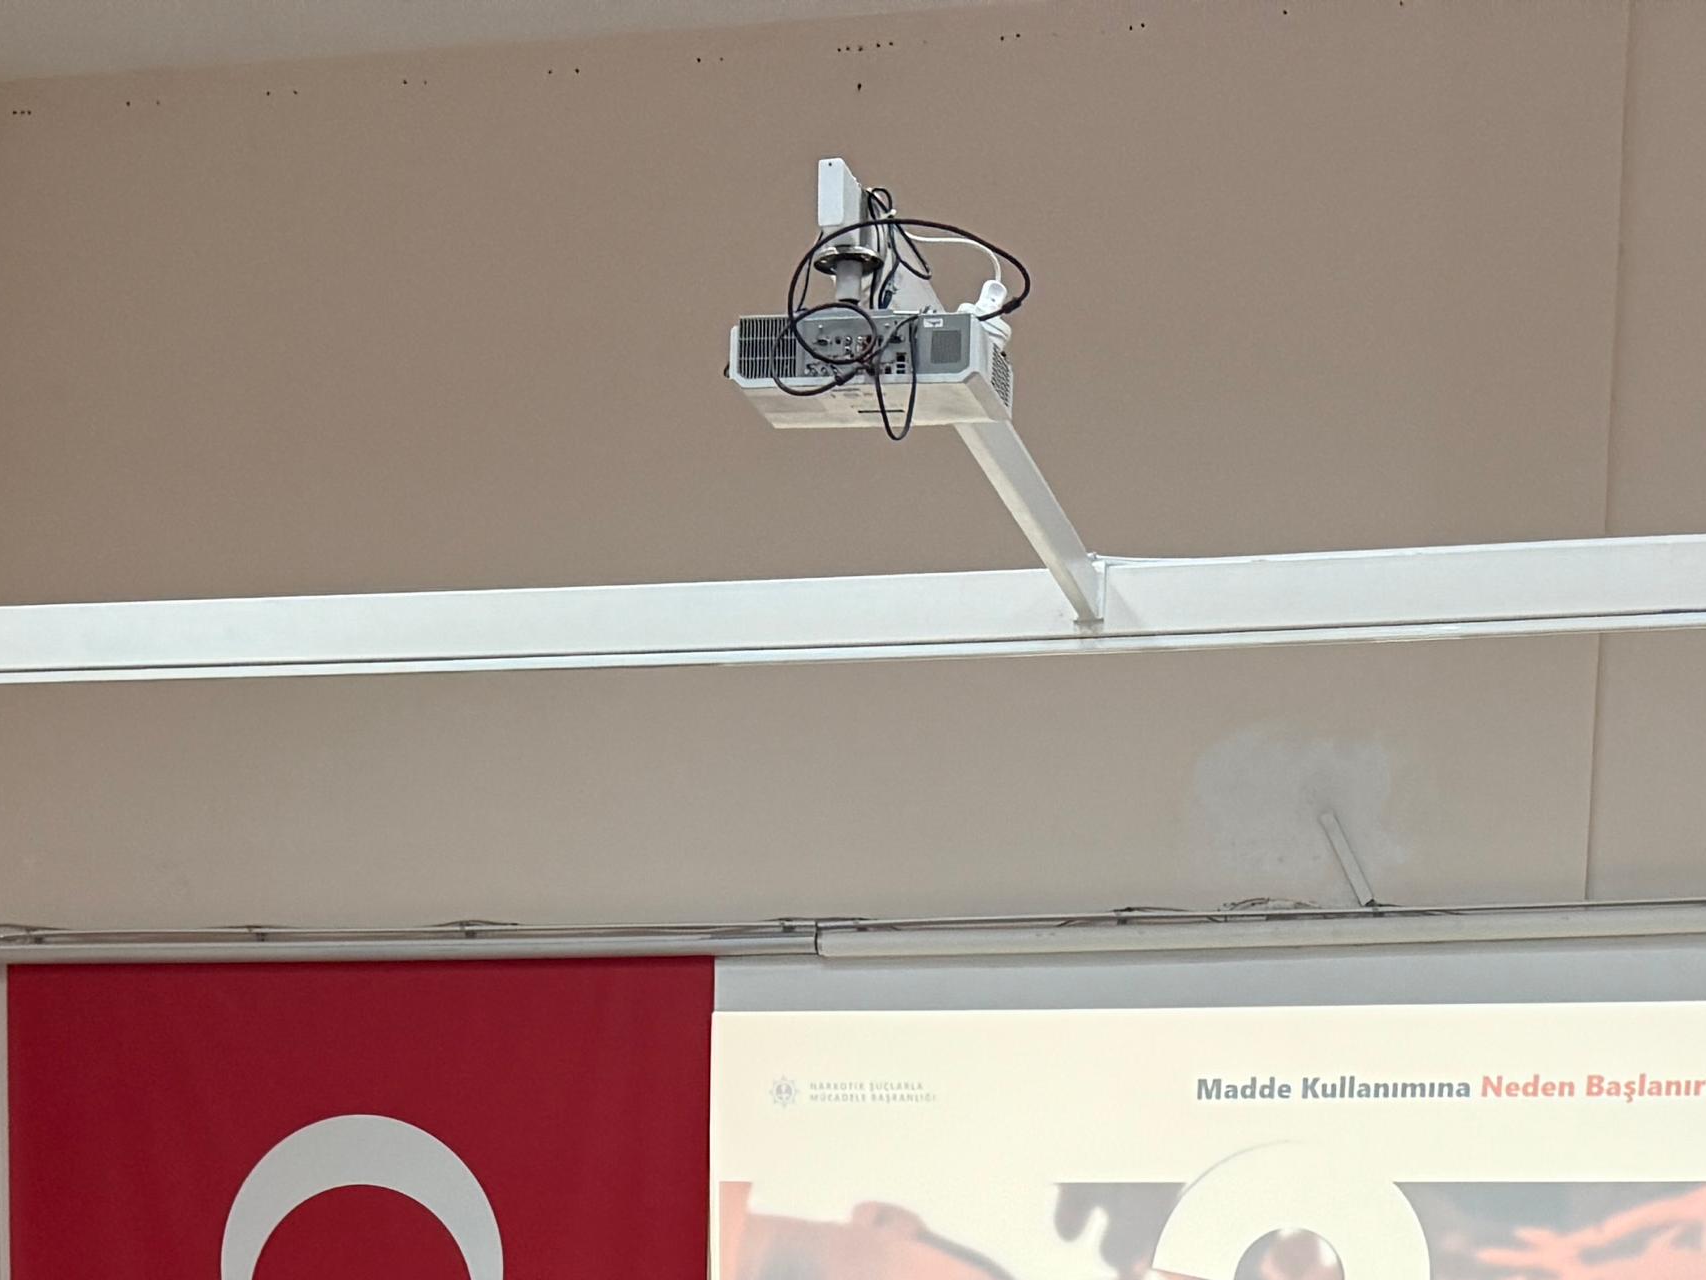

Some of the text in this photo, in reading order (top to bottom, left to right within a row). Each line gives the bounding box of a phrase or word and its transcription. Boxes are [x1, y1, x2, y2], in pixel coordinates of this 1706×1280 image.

[1197, 1076, 1292, 1100] Madde
[1302, 1075, 1471, 1099] Kullanımına
[1481, 1074, 1575, 1098] Neden
